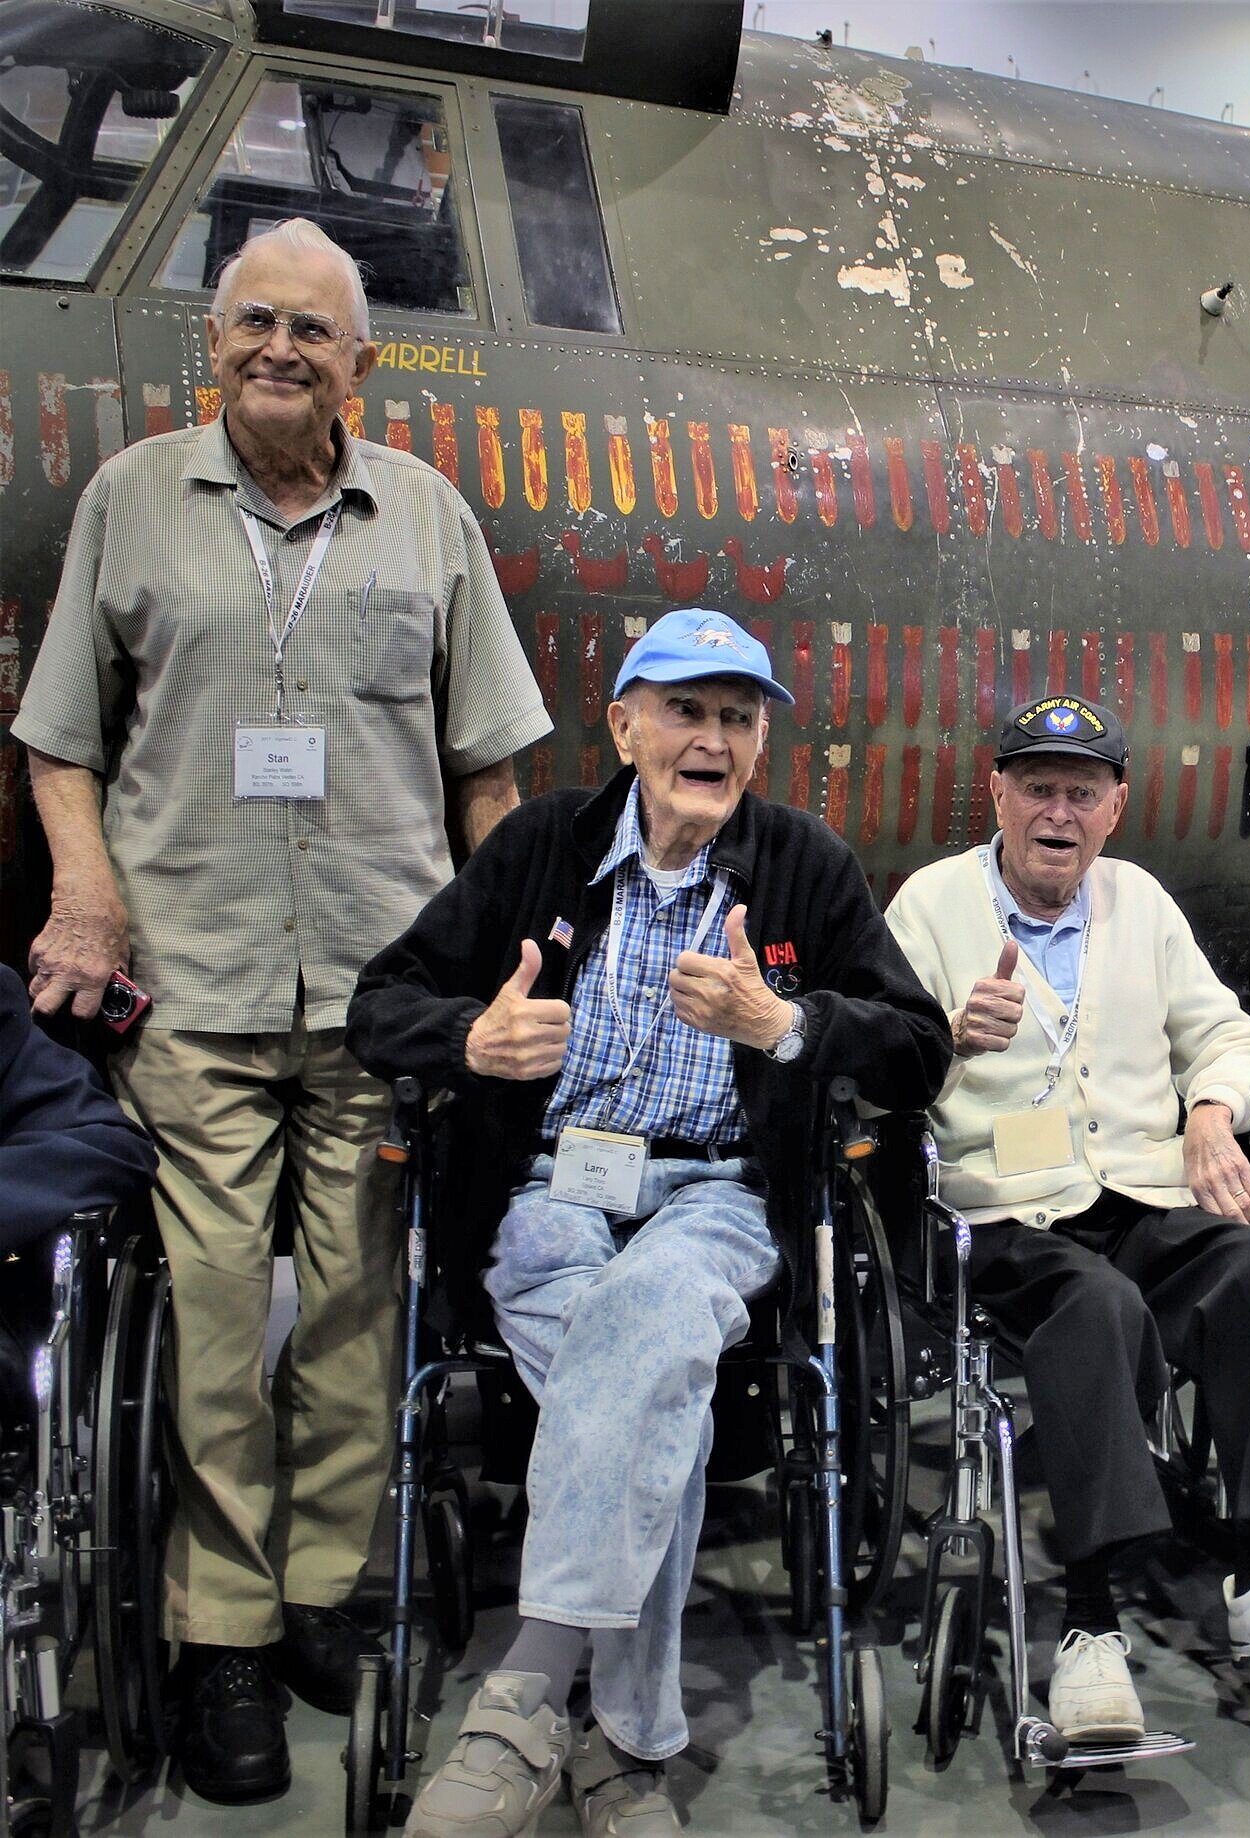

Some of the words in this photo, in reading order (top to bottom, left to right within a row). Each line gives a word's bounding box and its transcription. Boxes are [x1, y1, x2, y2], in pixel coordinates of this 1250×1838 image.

[370, 340, 487, 376] ARRELL
[294, 565, 316, 610] MARAUDER
[1018, 711, 1037, 725] U.S.
[1035, 699, 1062, 714] ARMY
[1062, 699, 1080, 711] AIR
[1080, 707, 1104, 732] CORPS
[267, 753, 289, 763] Stan
[613, 906, 623, 926] B-26
[764, 941, 798, 966] USA
[584, 1162, 609, 1177] Larry
